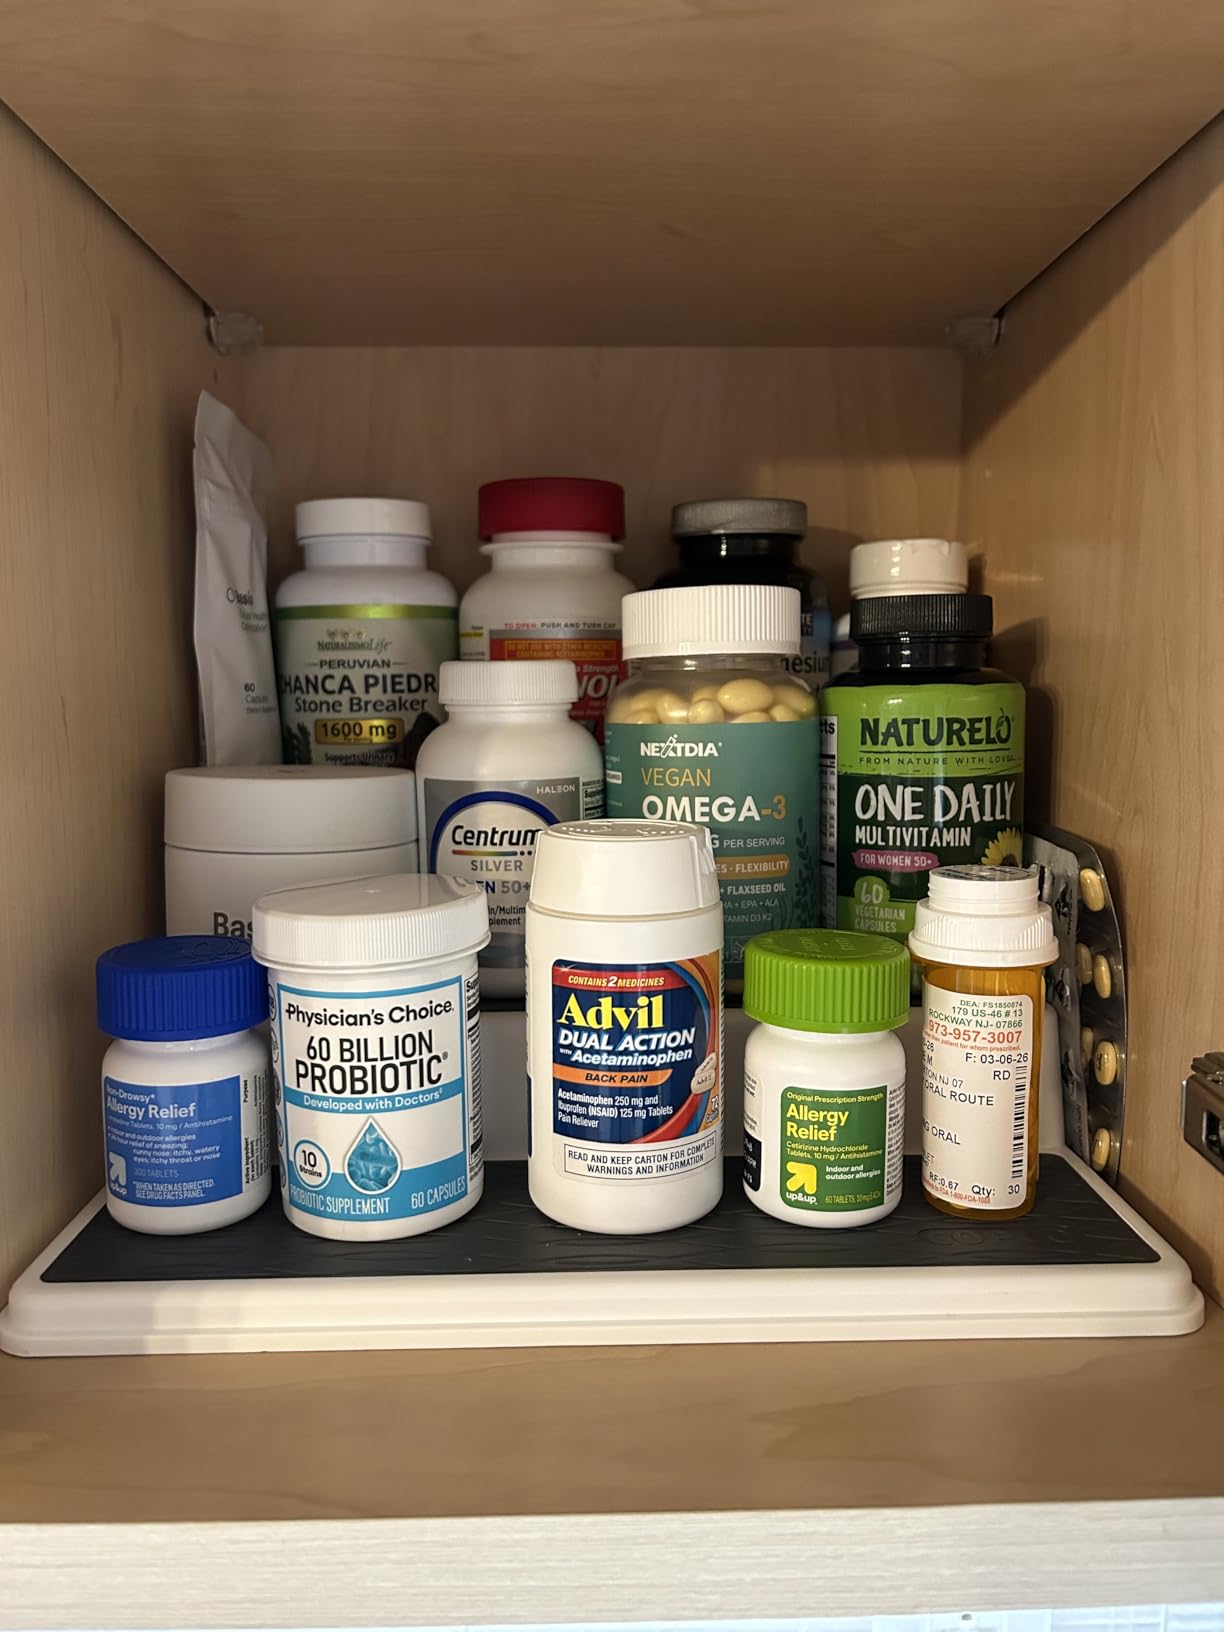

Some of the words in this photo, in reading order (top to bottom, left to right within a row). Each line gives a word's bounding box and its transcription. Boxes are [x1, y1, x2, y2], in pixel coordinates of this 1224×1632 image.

[319, 659, 392, 670] PERUVIAN
[295, 696, 343, 713] Stone
[349, 695, 429, 713] Breaker
[322, 721, 363, 738] 1600
[368, 723, 398, 740] mg
[859, 756, 890, 766] FROM
[897, 756, 948, 766] NATURE
[955, 756, 984, 766] WITH
[641, 767, 711, 787] VEGAN
[536, 784, 575, 795] HALEON
[642, 794, 787, 823] OMEGA-3
[855, 783, 924, 821] ONE
[933, 780, 1015, 823] DAILY
[723, 839, 744, 849] PER
[746, 836, 785, 848] SERVING
[855, 825, 971, 847] MULTIVITAMIN
[471, 859, 523, 872] SILVER
[860, 852, 876, 864] FOR
[877, 853, 911, 867] WOMEN
[913, 855, 932, 867] 50+
[735, 860, 789, 875] FLEXIBILITY
[500, 880, 530, 894] 50+
[727, 883, 771, 896] FLAXSEED
[772, 882, 786, 893] OIL
[860, 883, 884, 904] 60
[741, 900, 758, 909] EPA
[765, 898, 779, 907] ALA
[750, 913, 761, 922] D3
[762, 912, 773, 921] K2
[855, 905, 905, 921] VEGETARIAN
[855, 918, 897, 934] CAPSULES
[568, 975, 608, 987] CONTAINS
[608, 975, 618, 988] 2
[617, 976, 665, 988] MEDICINES
[960, 1000, 980, 1008] DEA:
[285, 1002, 384, 1027] Physician's
[556, 992, 664, 1032] Advil
[928, 1008, 972, 1027] ROCKWAY
[996, 1019, 1023, 1029] 07866
[952, 1006, 969, 1016] 179
[971, 1008, 1002, 1018] US-46
[1004, 1009, 1011, 1017] #
[1014, 1008, 1023, 1017] 13
[558, 1027, 614, 1051] DUAL
[615, 1026, 696, 1051] ACTION
[928, 1019, 1023, 1044] 973-957-3007
[306, 1036, 331, 1061] 60
[339, 1029, 433, 1063] BILLION
[571, 1047, 692, 1067] Acetaminophen
[965, 1052, 977, 1063] F:
[980, 1052, 1029, 1064] 03-06-26
[585, 1072, 617, 1083] BACK
[620, 1074, 648, 1084] PAIN
[993, 1070, 1011, 1081] RD
[952, 1078, 964, 1089] 07
[557, 1087, 613, 1106] Acetaminophen
[614, 1096, 630, 1106] 250
[631, 1097, 643, 1107] mg
[644, 1094, 659, 1105] and
[786, 1091, 814, 1102] Original
[814, 1095, 857, 1105] Prescription
[857, 1092, 884, 1103] Strength
[924, 1080, 946, 1098] ORAL
[950, 1090, 994, 1106] ROUTE
[107, 1096, 146, 1121] Allergy
[148, 1102, 197, 1119] Relief
[303, 1095, 366, 1113] Developed
[366, 1096, 393, 1110] with
[557, 1100, 587, 1116] Ibuprofen
[588, 1106, 619, 1119] (NSAID)
[619, 1107, 634, 1118] 125
[634, 1108, 647, 1119] mg
[648, 1104, 673, 1118] Tablets
[557, 1111, 572, 1122] Pain
[572, 1114, 599, 1129] Reliever
[786, 1103, 849, 1126] Allergy
[165, 1123, 178, 1131] mg
[786, 1121, 837, 1141] Relief
[136, 1133, 164, 1142] outdoor
[164, 1133, 197, 1143] allergies
[931, 1126, 961, 1145] ORAL
[146, 1141, 153, 1149] of
[194, 1144, 220, 1154] watery
[568, 1150, 589, 1162] READ
[590, 1153, 609, 1164] AND
[610, 1155, 632, 1165] KEEP
[634, 1152, 668, 1165] CARTON
[670, 1149, 686, 1161] FOR
[686, 1136, 715, 1157] COMPLETE
[786, 1141, 819, 1152] Cetirizine
[819, 1143, 869, 1154] Hydrochloride
[169, 1155, 193, 1164] throat
[203, 1152, 220, 1160] nose
[301, 1149, 317, 1168] 10
[813, 1152, 822, 1160] 10
[822, 1153, 835, 1162] mg
[840, 1148, 883, 1160] Antihistamine
[299, 1164, 322, 1178] Strains
[586, 1163, 634, 1176] WARNINGS
[635, 1163, 654, 1175] AND
[656, 1152, 704, 1174] INFORMATION
[825, 1165, 849, 1173] Indoor
[849, 1164, 864, 1172] and
[147, 1168, 179, 1178] TABLETS
[825, 1172, 855, 1180] outdoor
[855, 1168, 881, 1179] allergies
[152, 1181, 174, 1191] TAKEN
[174, 1182, 183, 1191] AS
[411, 1191, 425, 1209] 60
[426, 1175, 466, 1206] CAPSULES
[971, 1184, 996, 1197] Qty:
[1007, 1183, 1020, 1195] 30
[136, 1190, 149, 1199] SEE
[148, 1190, 163, 1200] DRUG
[162, 1190, 184, 1200] FACTS
[290, 1183, 325, 1211] PROBIOTIC
[326, 1196, 390, 1216] SUPPLEMENT
[786, 1191, 818, 1205] up&up
